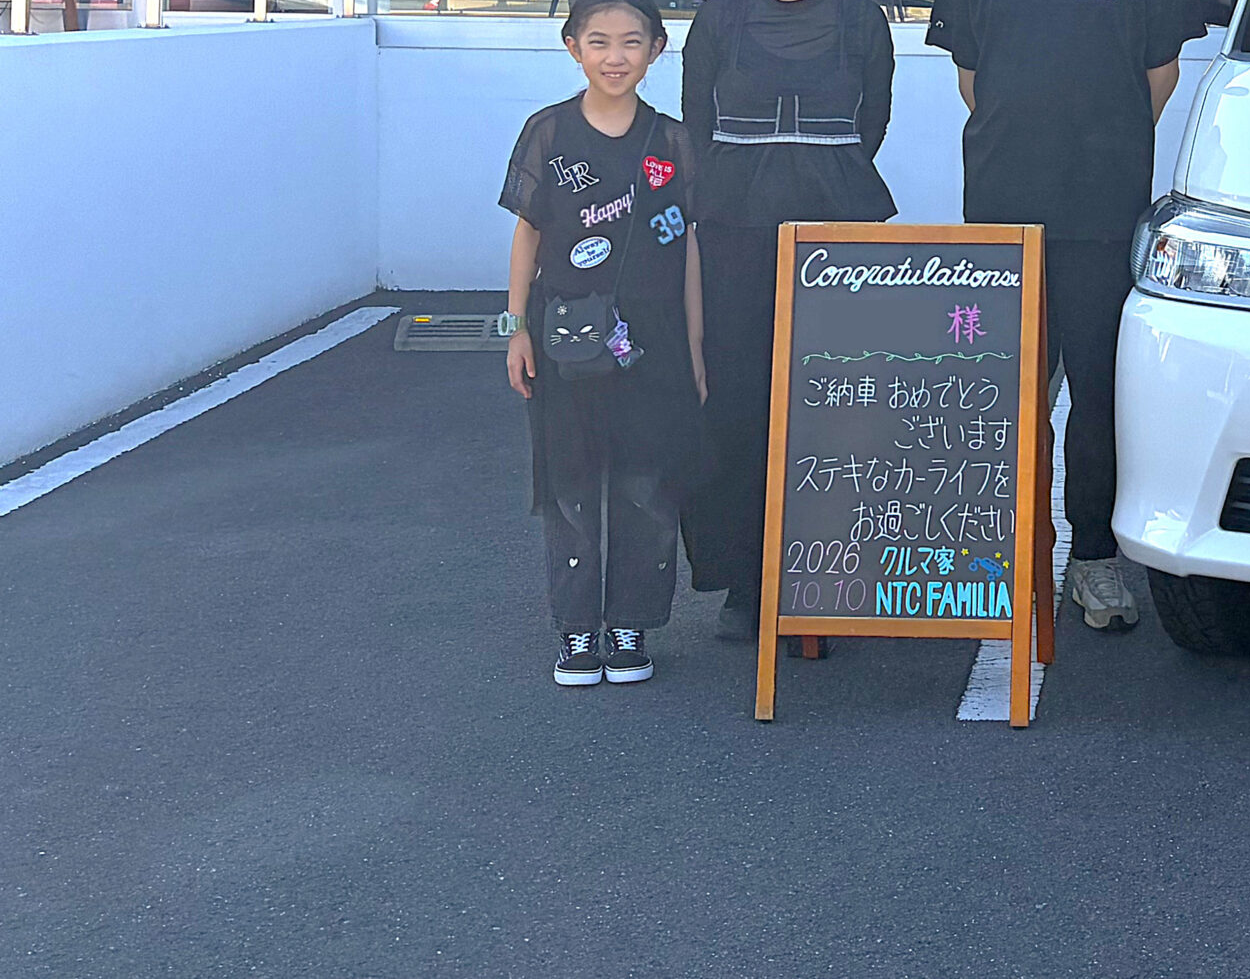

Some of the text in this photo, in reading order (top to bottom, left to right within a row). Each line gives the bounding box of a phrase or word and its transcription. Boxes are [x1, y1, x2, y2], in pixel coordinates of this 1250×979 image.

[650, 205, 686, 245] 39
[946, 303, 988, 345] 様
[803, 375, 999, 411] ご納車 おめでとう
[894, 415, 1012, 451] ございます
[796, 454, 1010, 498] ステキなカーライフを
[849, 500, 1015, 542] お過ごしください
[786, 540, 861, 574] 2026
[879, 546, 956, 577] クルマ家
[875, 581, 1013, 618] NTC FAMILIA
